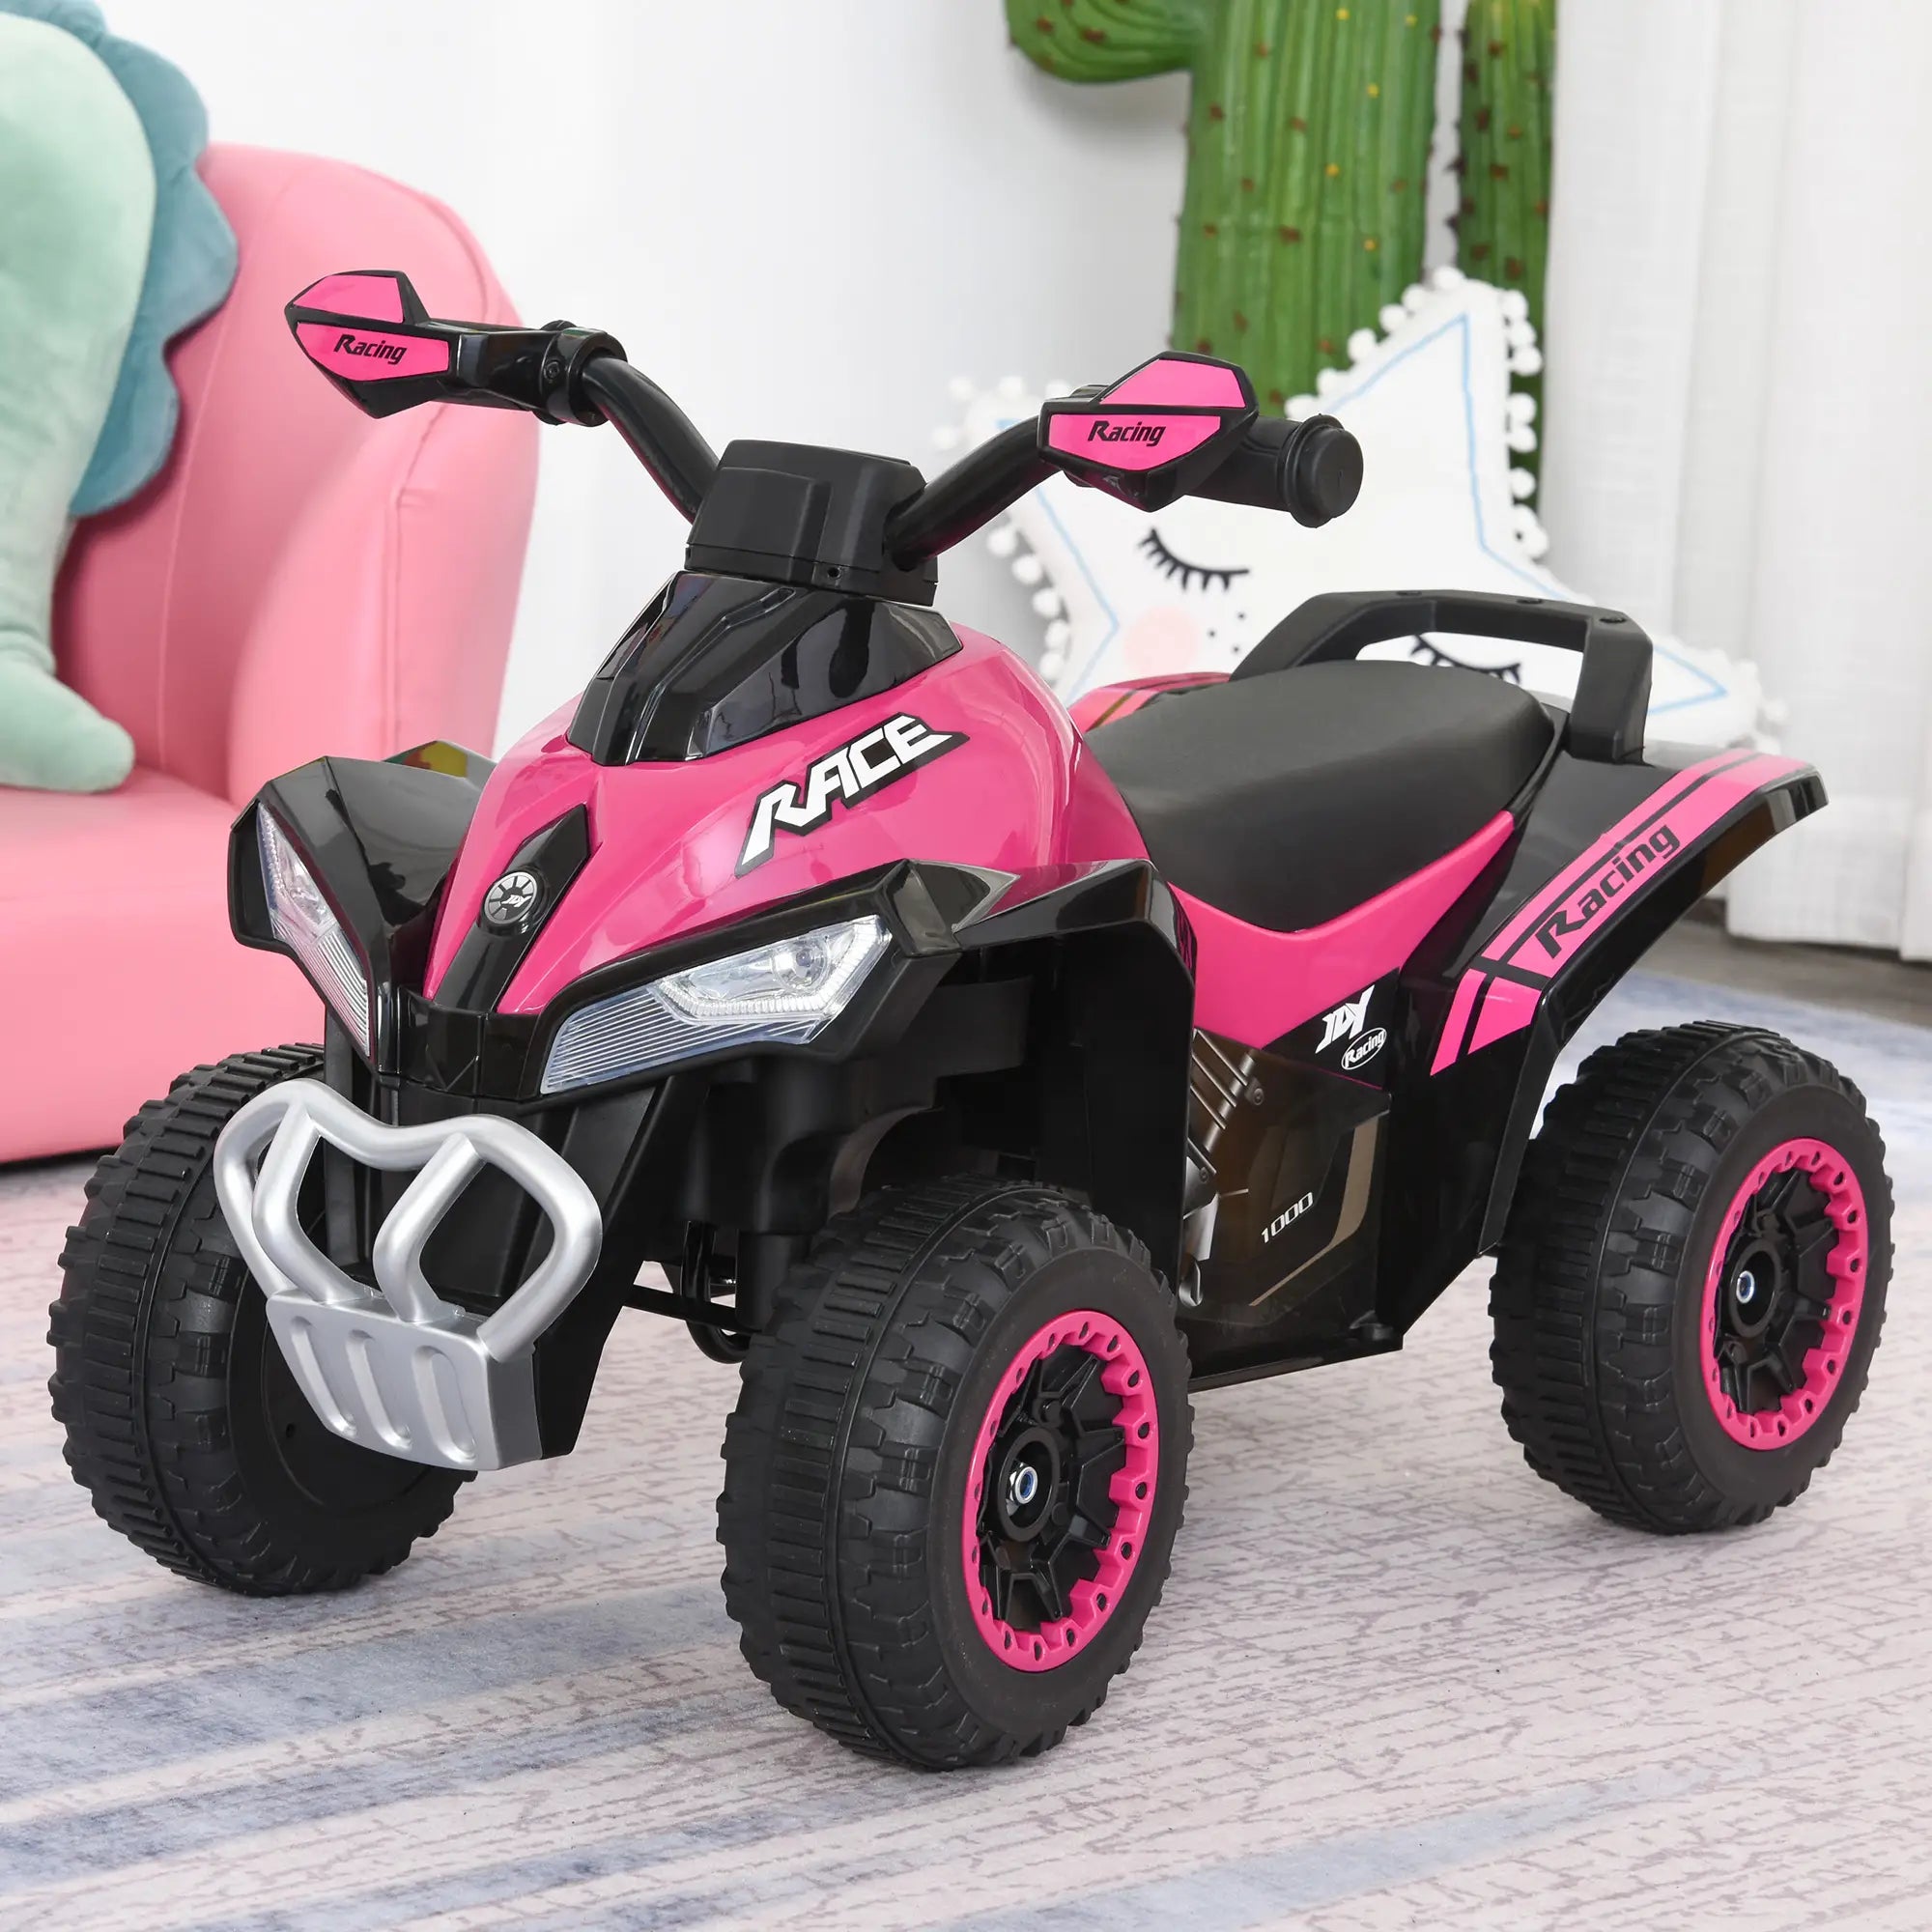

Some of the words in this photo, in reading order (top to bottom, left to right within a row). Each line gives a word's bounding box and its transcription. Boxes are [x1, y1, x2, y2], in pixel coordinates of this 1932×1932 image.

[333, 334, 407, 365] Racing
[1088, 420, 1166, 447] Racing
[741, 715, 952, 866] RACE
[1535, 824, 1681, 959] Racing
[1315, 984, 1376, 1054] JDY
[1344, 1030, 1385, 1068] Racing
[1261, 1191, 1314, 1243] 1000
